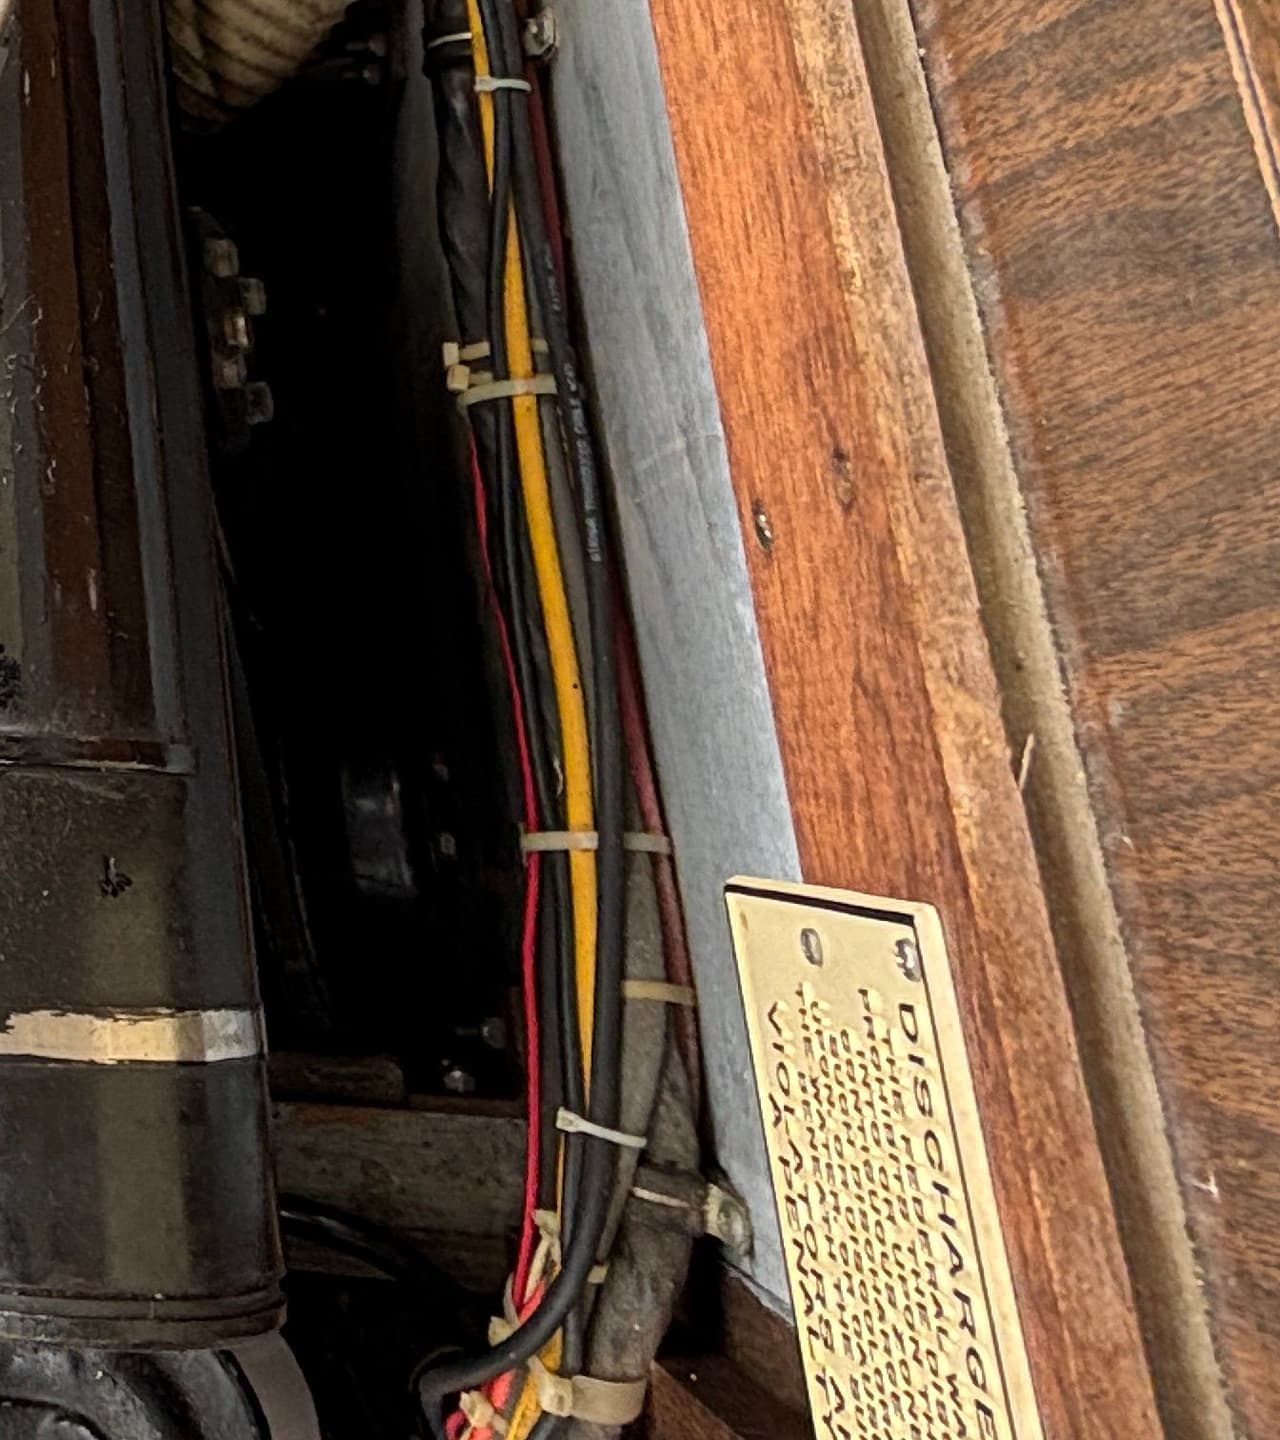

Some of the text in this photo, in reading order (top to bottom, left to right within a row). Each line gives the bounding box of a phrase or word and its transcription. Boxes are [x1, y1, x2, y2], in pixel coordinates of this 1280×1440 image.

[765, 1000, 835, 1353] VIOLATORS
[766, 1089, 783, 1129] A
[794, 982, 815, 1062] THE
[836, 1241, 855, 1297] OR
[796, 1069, 837, 1261] BENEATH
[832, 1276, 855, 1360] THE
[826, 1033, 906, 1422] SUCH DISCHARGE
[831, 1133, 849, 1189] OR
[839, 1028, 898, 1310] CONTIGUOUS
[855, 1049, 883, 1148] INTO
[876, 1165, 897, 1226] OR
[890, 1242, 923, 1367] UPON
[856, 988, 911, 1222] PROHIBITS
[906, 1239, 931, 1332] THE
[880, 1028, 907, 1118] THE
[899, 1133, 949, 1350] FEDERAL
[896, 1002, 998, 1440] DISCHARGE
